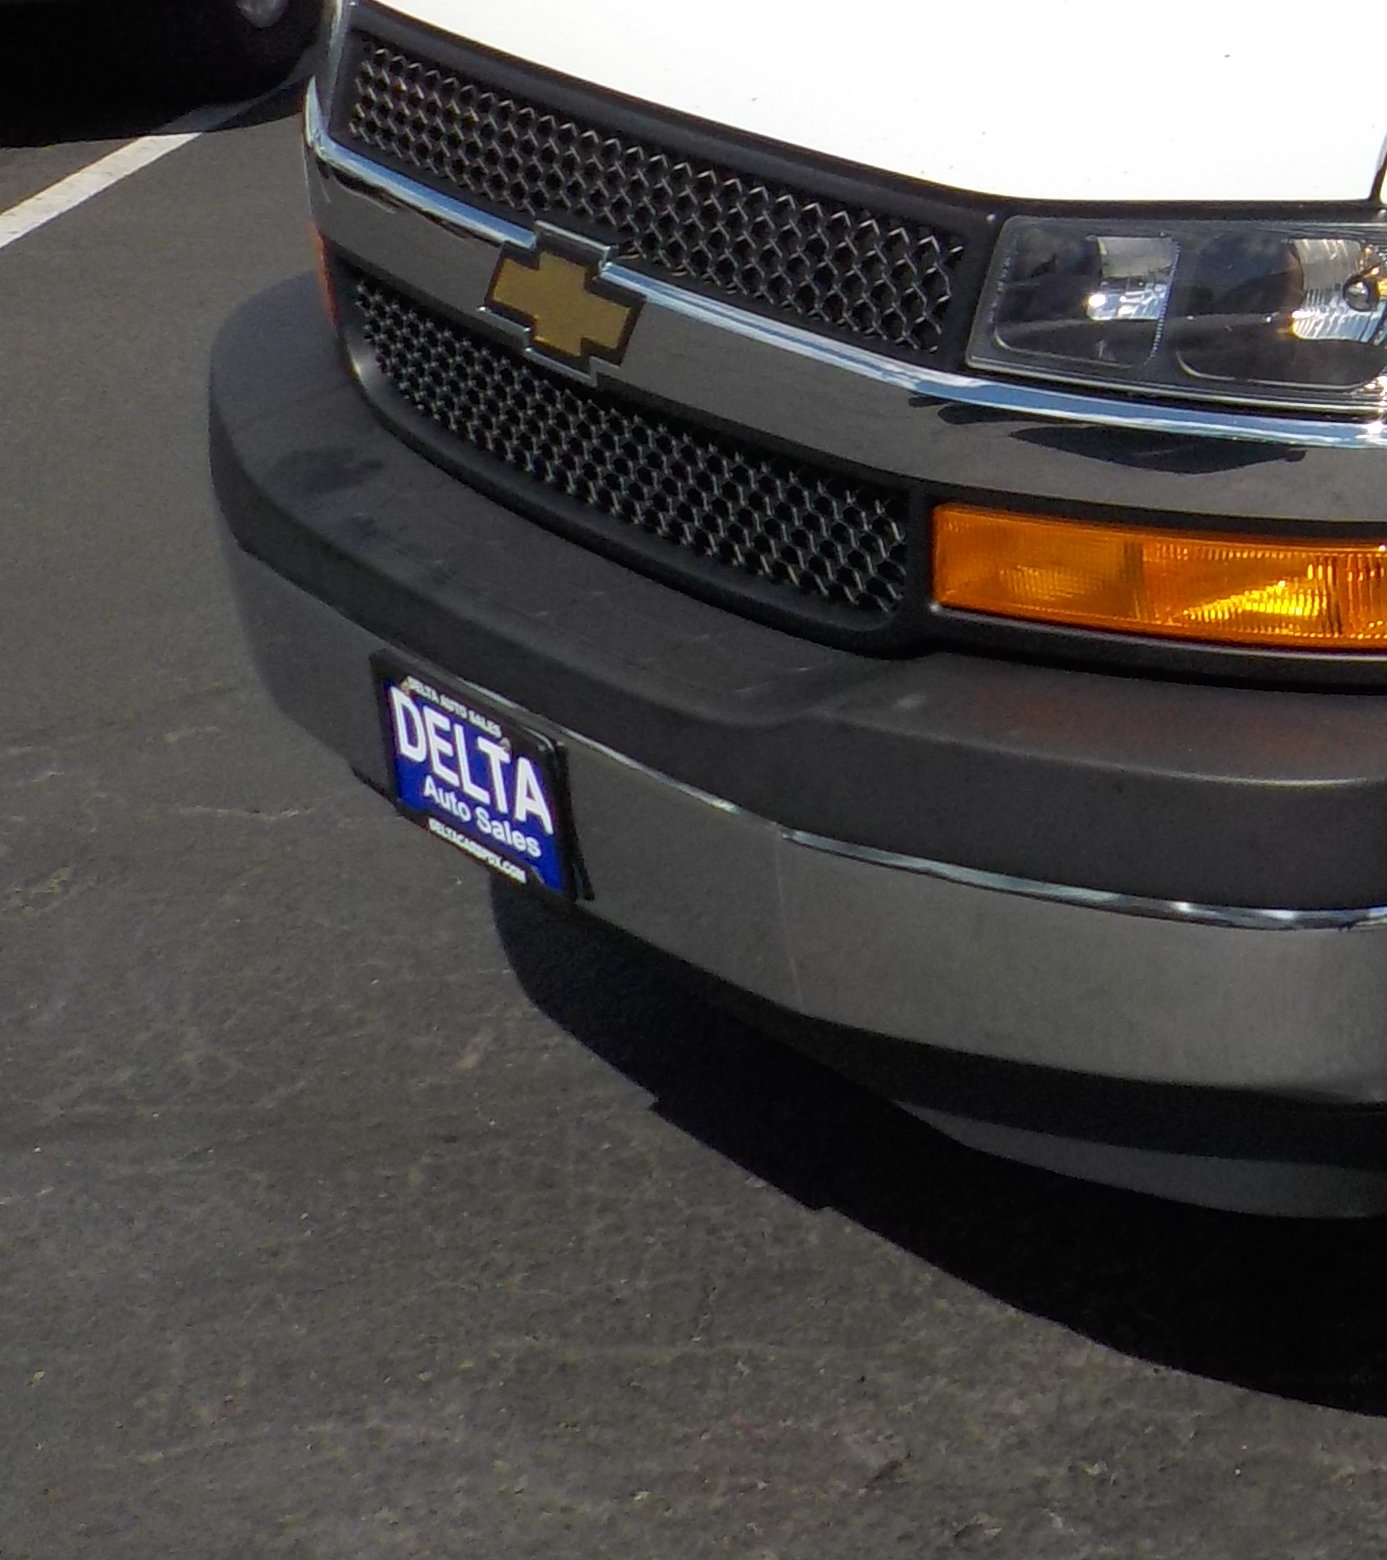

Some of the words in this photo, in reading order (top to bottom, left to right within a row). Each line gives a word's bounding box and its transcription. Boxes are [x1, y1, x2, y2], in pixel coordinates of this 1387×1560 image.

[390, 685, 554, 835] DELTA
[423, 774, 471, 823] Auto
[475, 807, 543, 858] Sales
